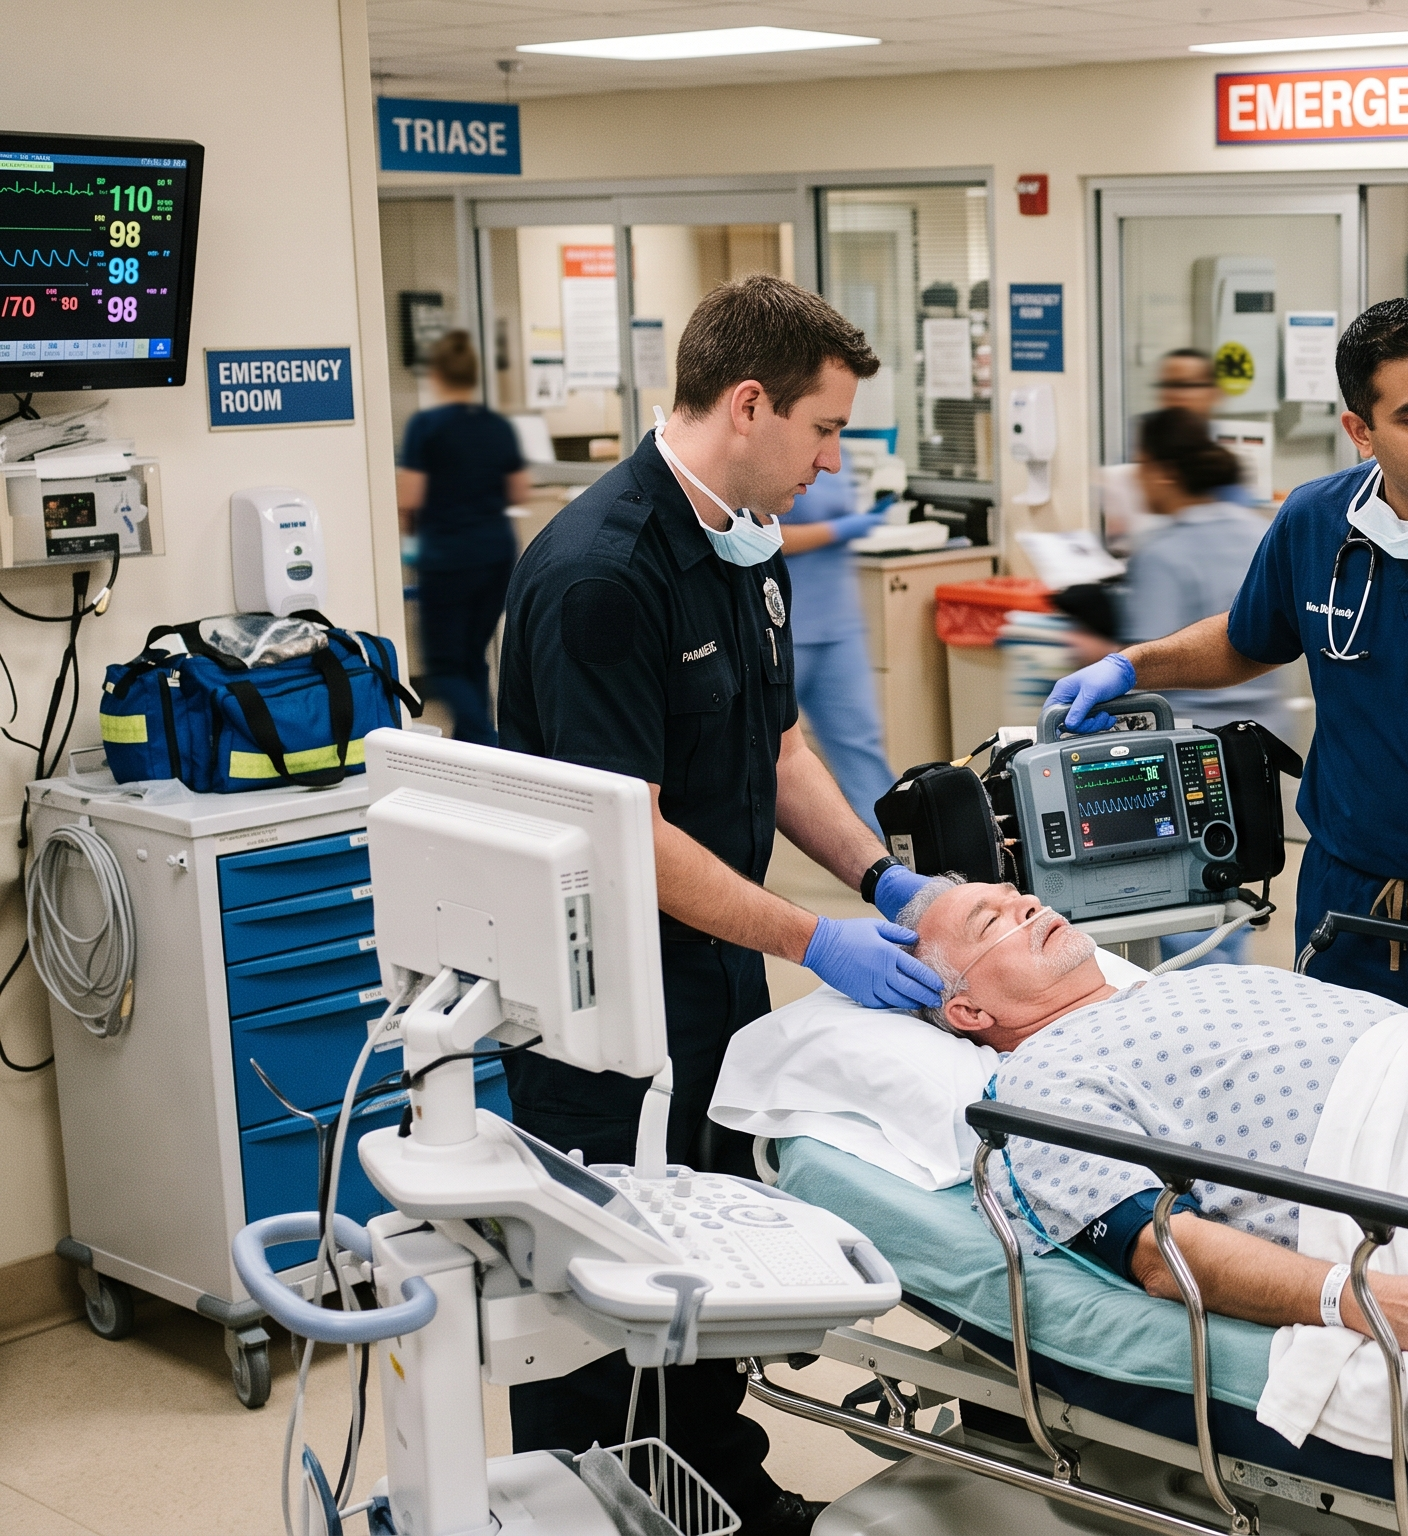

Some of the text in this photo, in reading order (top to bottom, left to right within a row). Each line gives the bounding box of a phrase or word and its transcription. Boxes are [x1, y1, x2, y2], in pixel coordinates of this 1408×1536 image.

[391, 117, 508, 156] TRIASE
[109, 185, 153, 213] 110
[109, 220, 141, 248] 98
[108, 257, 139, 284] 98
[107, 296, 138, 323] 98
[219, 359, 342, 385] EMERGENCY
[220, 389, 282, 413] ROOM
